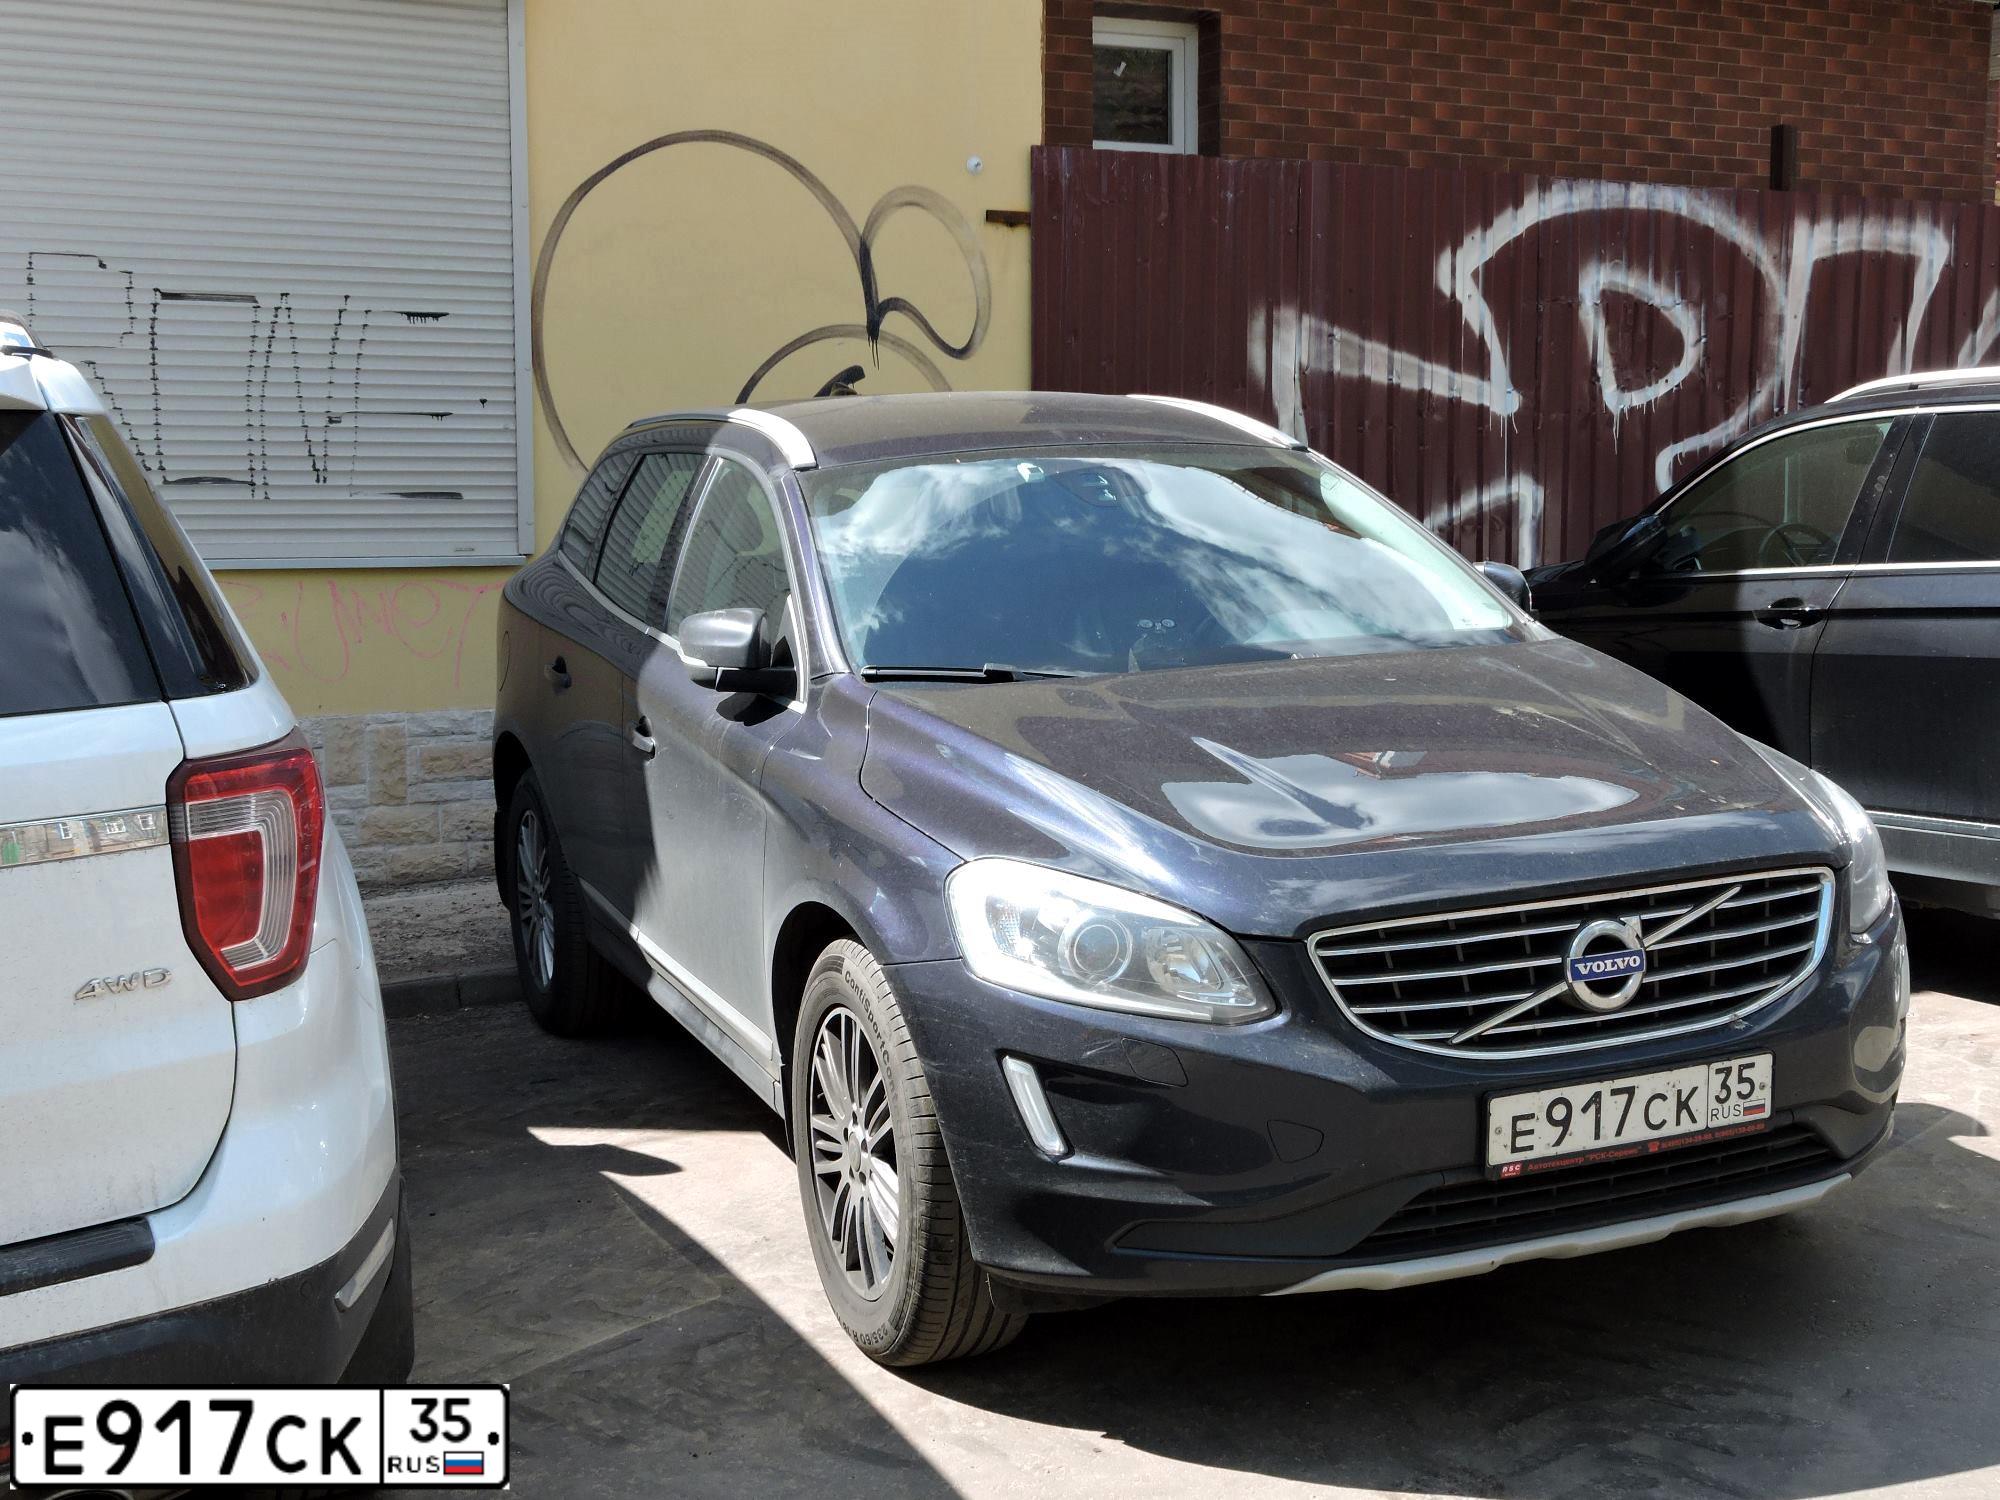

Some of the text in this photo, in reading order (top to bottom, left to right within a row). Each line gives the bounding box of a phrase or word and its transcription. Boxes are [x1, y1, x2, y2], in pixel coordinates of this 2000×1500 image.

[1575, 956, 1640, 975] VOLVO
[74, 967, 173, 1000] 4WD
[1510, 1062, 1756, 1154] E917CK 35
[1710, 1104, 1741, 1122] RUS
